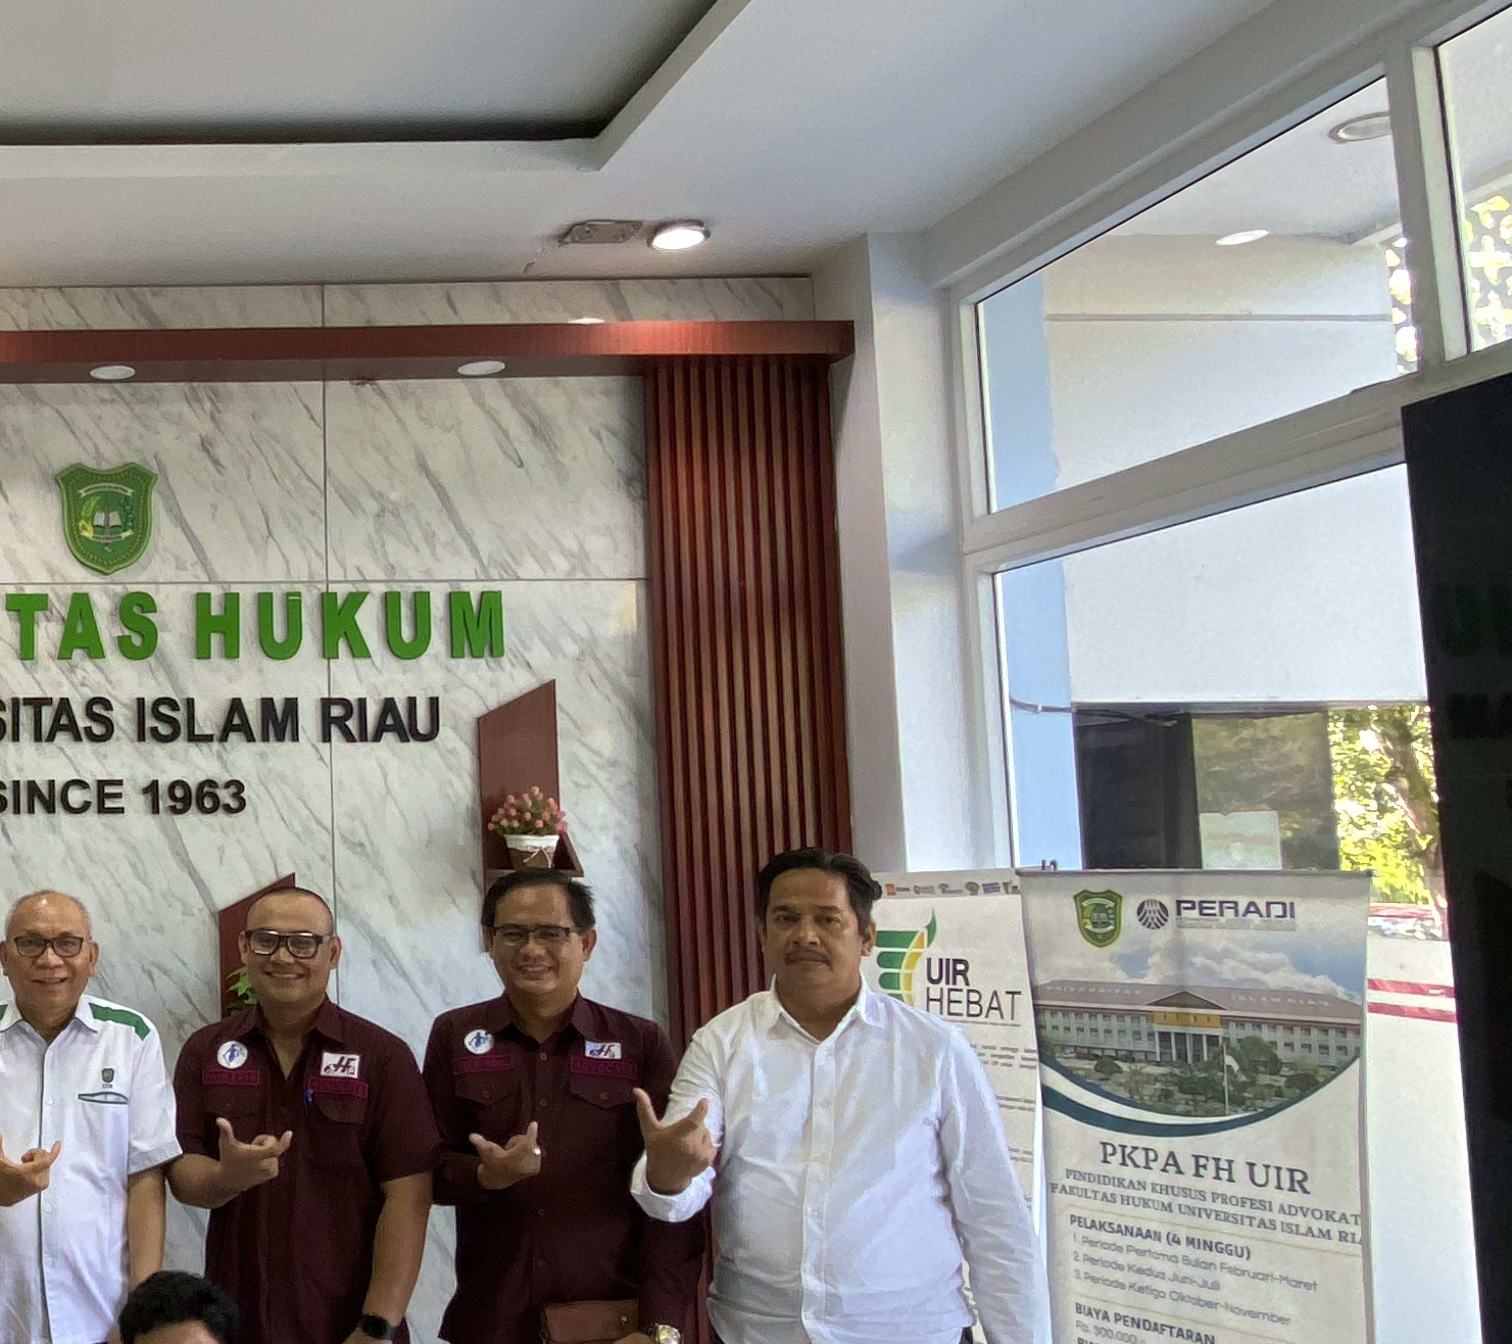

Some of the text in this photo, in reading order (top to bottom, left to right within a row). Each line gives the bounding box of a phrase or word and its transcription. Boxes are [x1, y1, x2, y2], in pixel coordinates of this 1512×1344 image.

[195, 590, 506, 660] HUKUM
[135, 696, 300, 744] ISLAM
[320, 696, 441, 744] RIAU
[141, 777, 248, 816] 1963
[1175, 899, 1296, 919] PERADI
[926, 956, 970, 987] UIR
[925, 986, 1023, 1021] HEBAT
[1099, 1140, 1312, 1195] PKPA FH UIR
[1050, 1182, 1362, 1245] FAKULTAS HUKUM UNIVERSITAS ISLAM RI
[1064, 1168, 1361, 1227] PENDIDIKAN KHUSUS PROFESI ADVOKAT
[1069, 1213, 1163, 1244] PELAKSANAAN
[1185, 1235, 1252, 1261] MINGGU)
[1075, 1302, 1111, 1323] BIAYA
